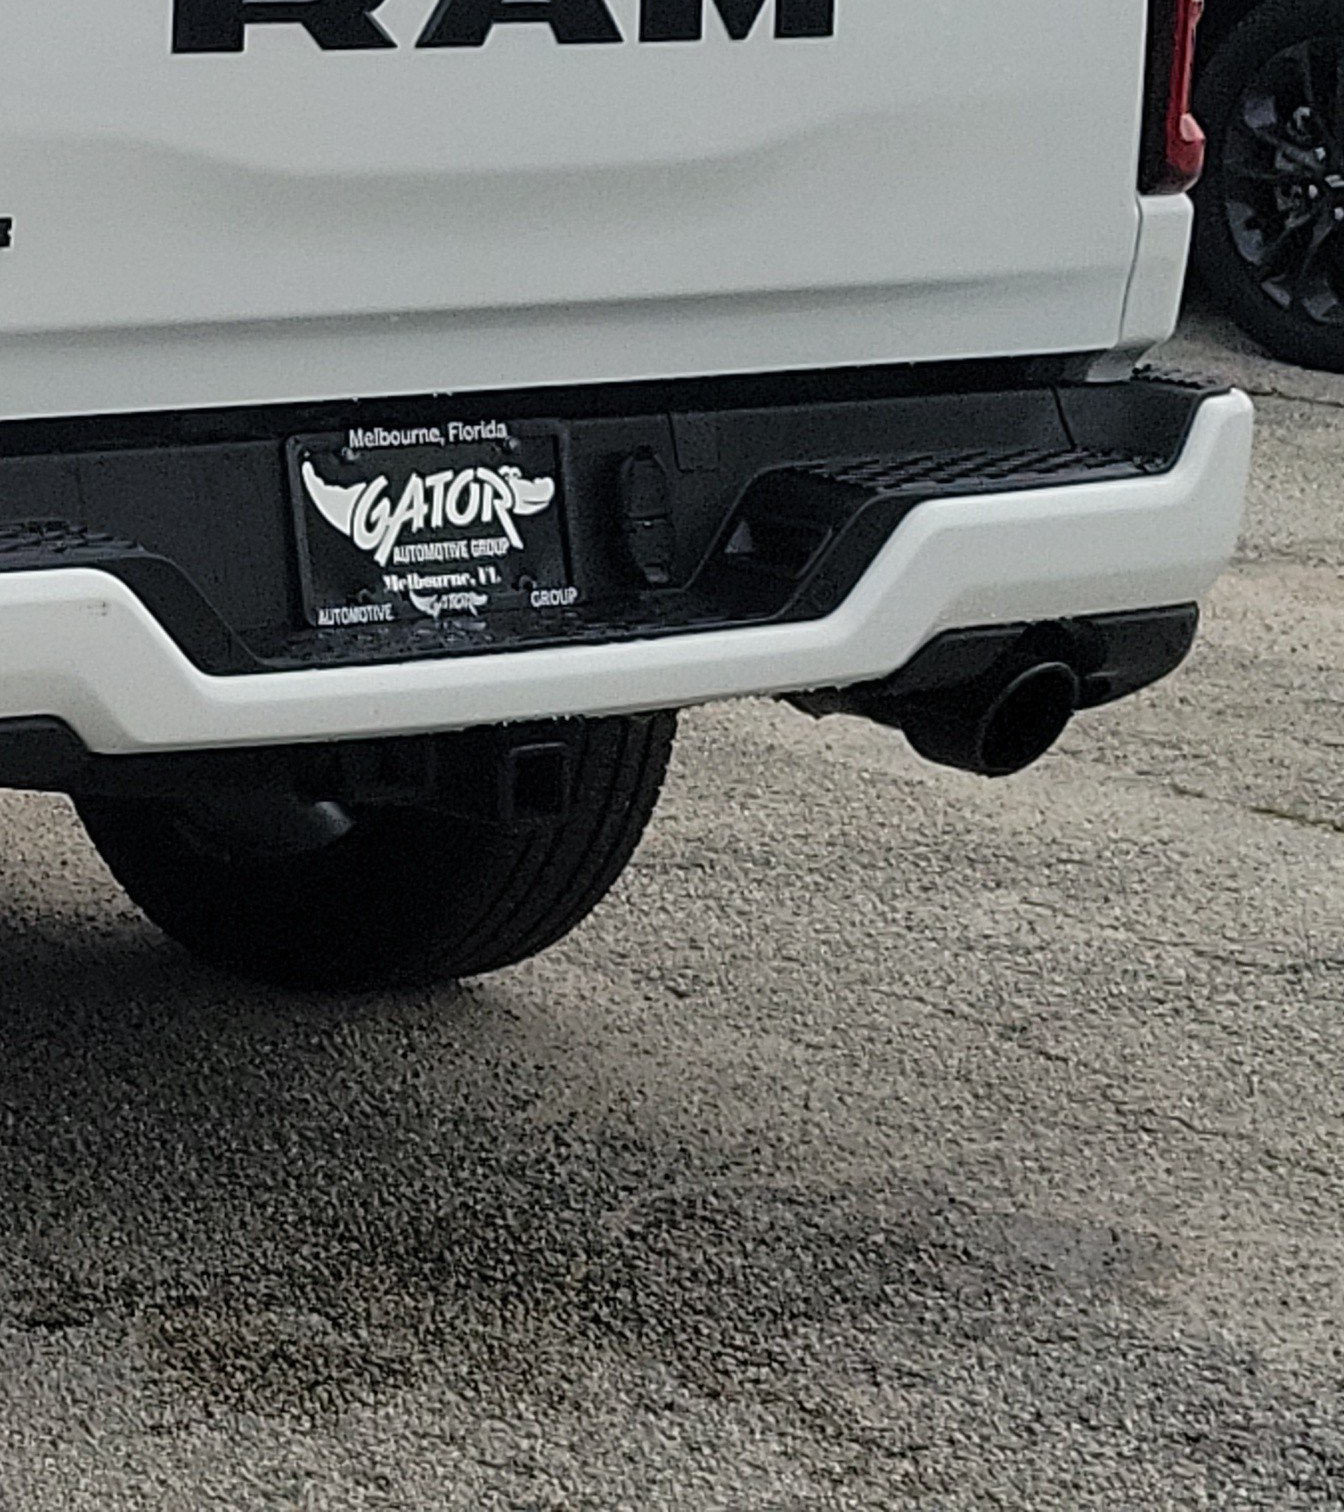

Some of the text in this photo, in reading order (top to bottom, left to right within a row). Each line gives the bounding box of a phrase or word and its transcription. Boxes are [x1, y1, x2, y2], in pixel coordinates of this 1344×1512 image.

[348, 419, 508, 448] Melbourne, Florida
[353, 467, 524, 567] GATOR
[393, 536, 510, 564] AUTOMOTIVE GROUP
[317, 603, 395, 626] AUTOMOTIVE
[530, 587, 579, 607] GROUP
